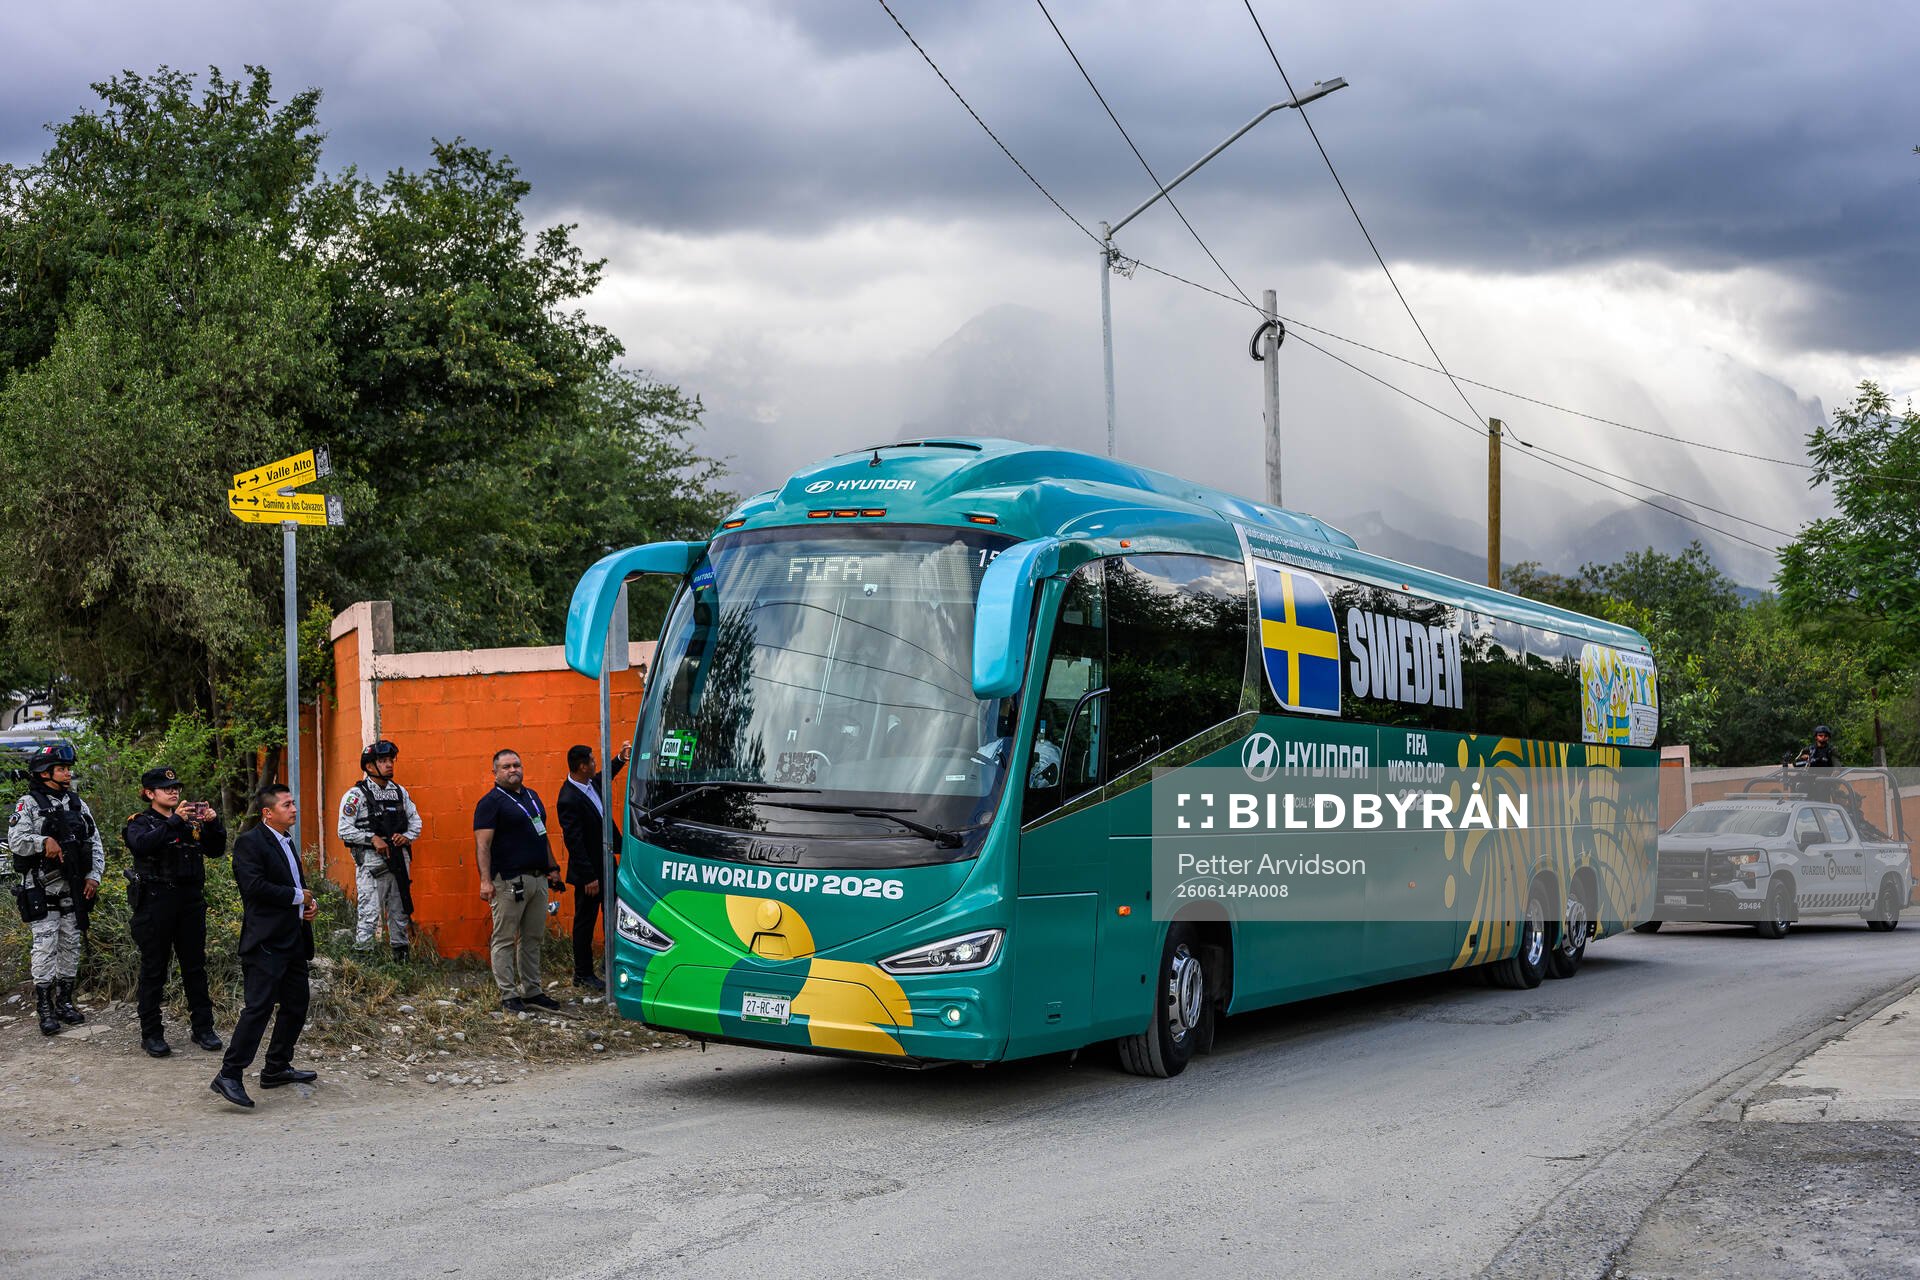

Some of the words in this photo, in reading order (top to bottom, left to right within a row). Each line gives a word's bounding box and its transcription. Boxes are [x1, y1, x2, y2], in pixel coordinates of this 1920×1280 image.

[266, 467, 290, 482] Valle
[293, 458, 312, 473] Alto
[836, 479, 916, 491] HYUNDAI
[262, 497, 285, 510] Camino
[286, 501, 290, 509] a
[292, 499, 300, 511] los
[301, 500, 324, 512] Cavazos
[788, 556, 864, 581] FIFA
[1347, 607, 1463, 710] SWEDEN
[1406, 732, 1428, 756] FIFA
[1285, 741, 1368, 779] HYUNDAI
[1387, 759, 1425, 783] WORLD
[1426, 761, 1446, 784] CUP
[661, 861, 698, 883] FIFA
[702, 864, 772, 890] WORLD
[775, 871, 819, 893] CUP
[821, 874, 904, 900] 2026
[1801, 865, 1826, 876] GUARDIA
[1836, 865, 1863, 876] NACIONAL
[746, 1000, 785, 1016] 27-RC-4Y
